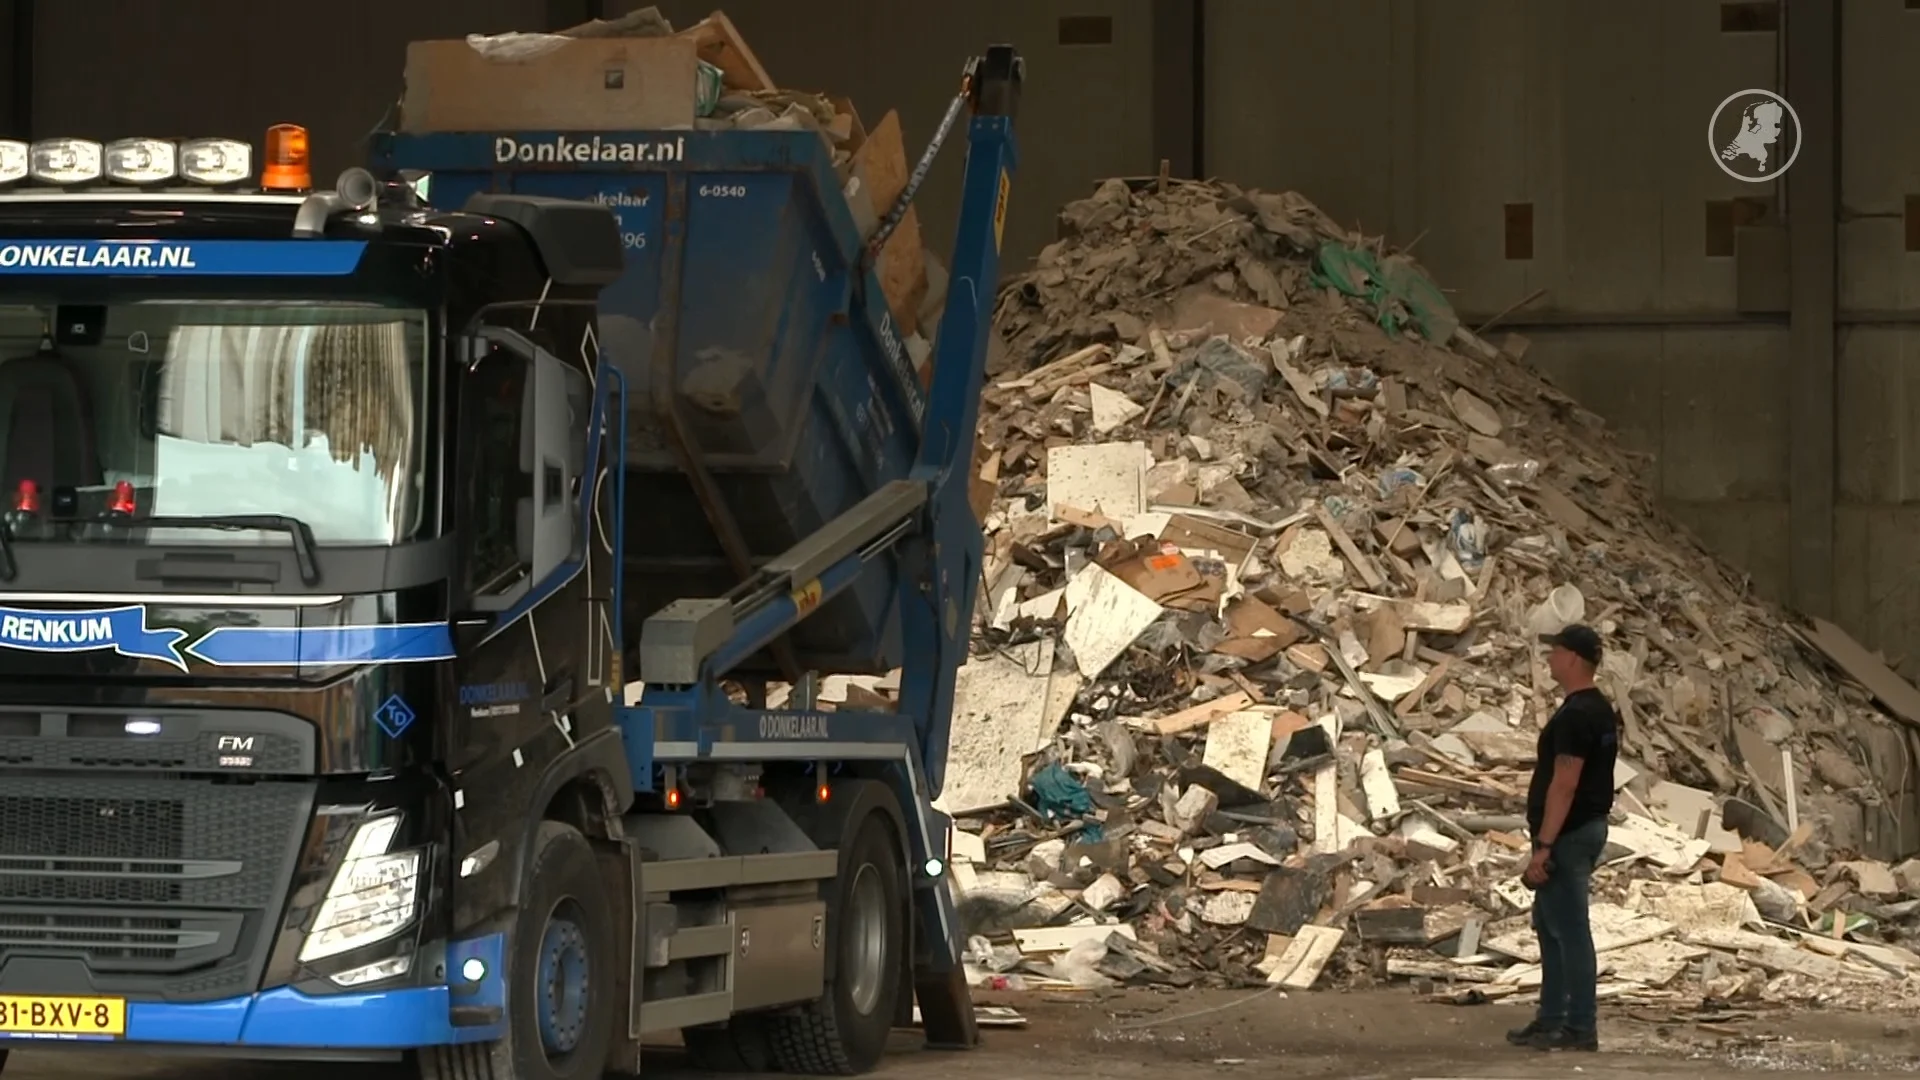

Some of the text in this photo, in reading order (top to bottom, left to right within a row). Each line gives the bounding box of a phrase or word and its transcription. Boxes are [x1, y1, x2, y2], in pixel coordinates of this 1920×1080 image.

[495, 136, 685, 162] Donkelaar.nl
[699, 185, 746, 198] 6-0540
[0, 245, 196, 268] ONKELAAR.NL
[1, 615, 113, 643] RENKUM
[217, 735, 255, 751] FM
